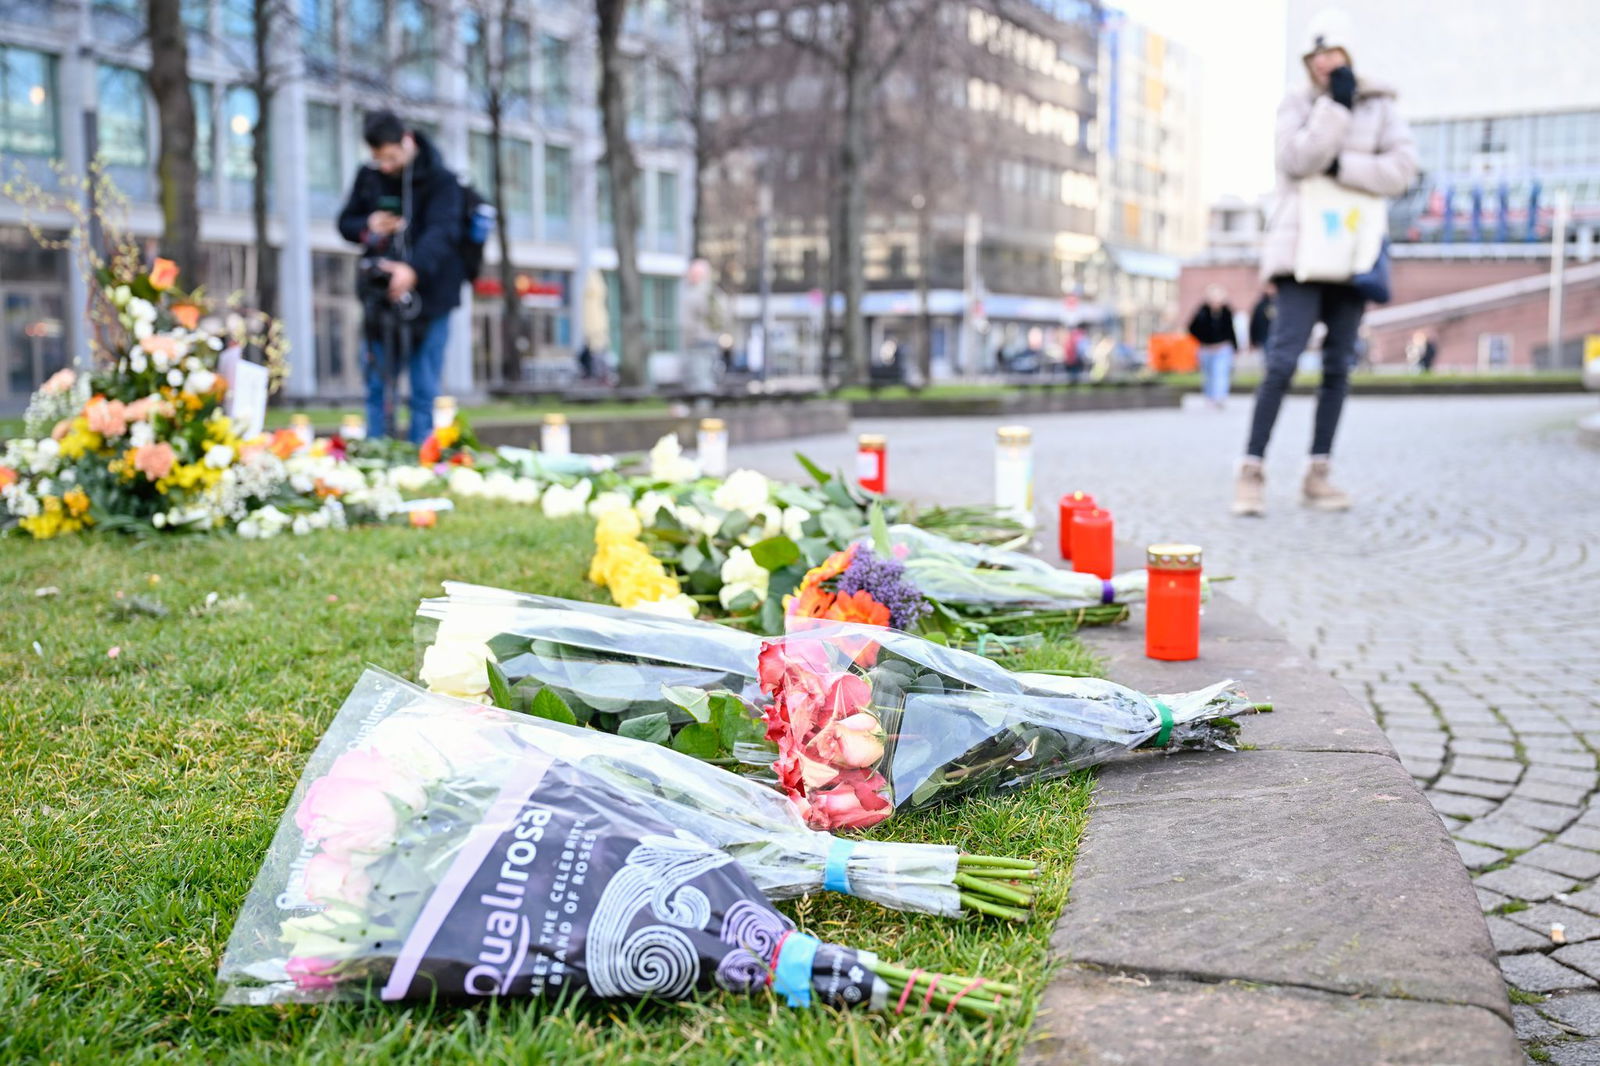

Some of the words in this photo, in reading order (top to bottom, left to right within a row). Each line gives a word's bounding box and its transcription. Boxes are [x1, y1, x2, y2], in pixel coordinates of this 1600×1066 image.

[464, 809, 553, 996] Qualirosa
[539, 910, 558, 944] THE
[550, 819, 585, 902] CELEBRITY
[549, 921, 572, 985] BRAND
[564, 891, 580, 914] OF
[572, 833, 597, 885] ROSES
